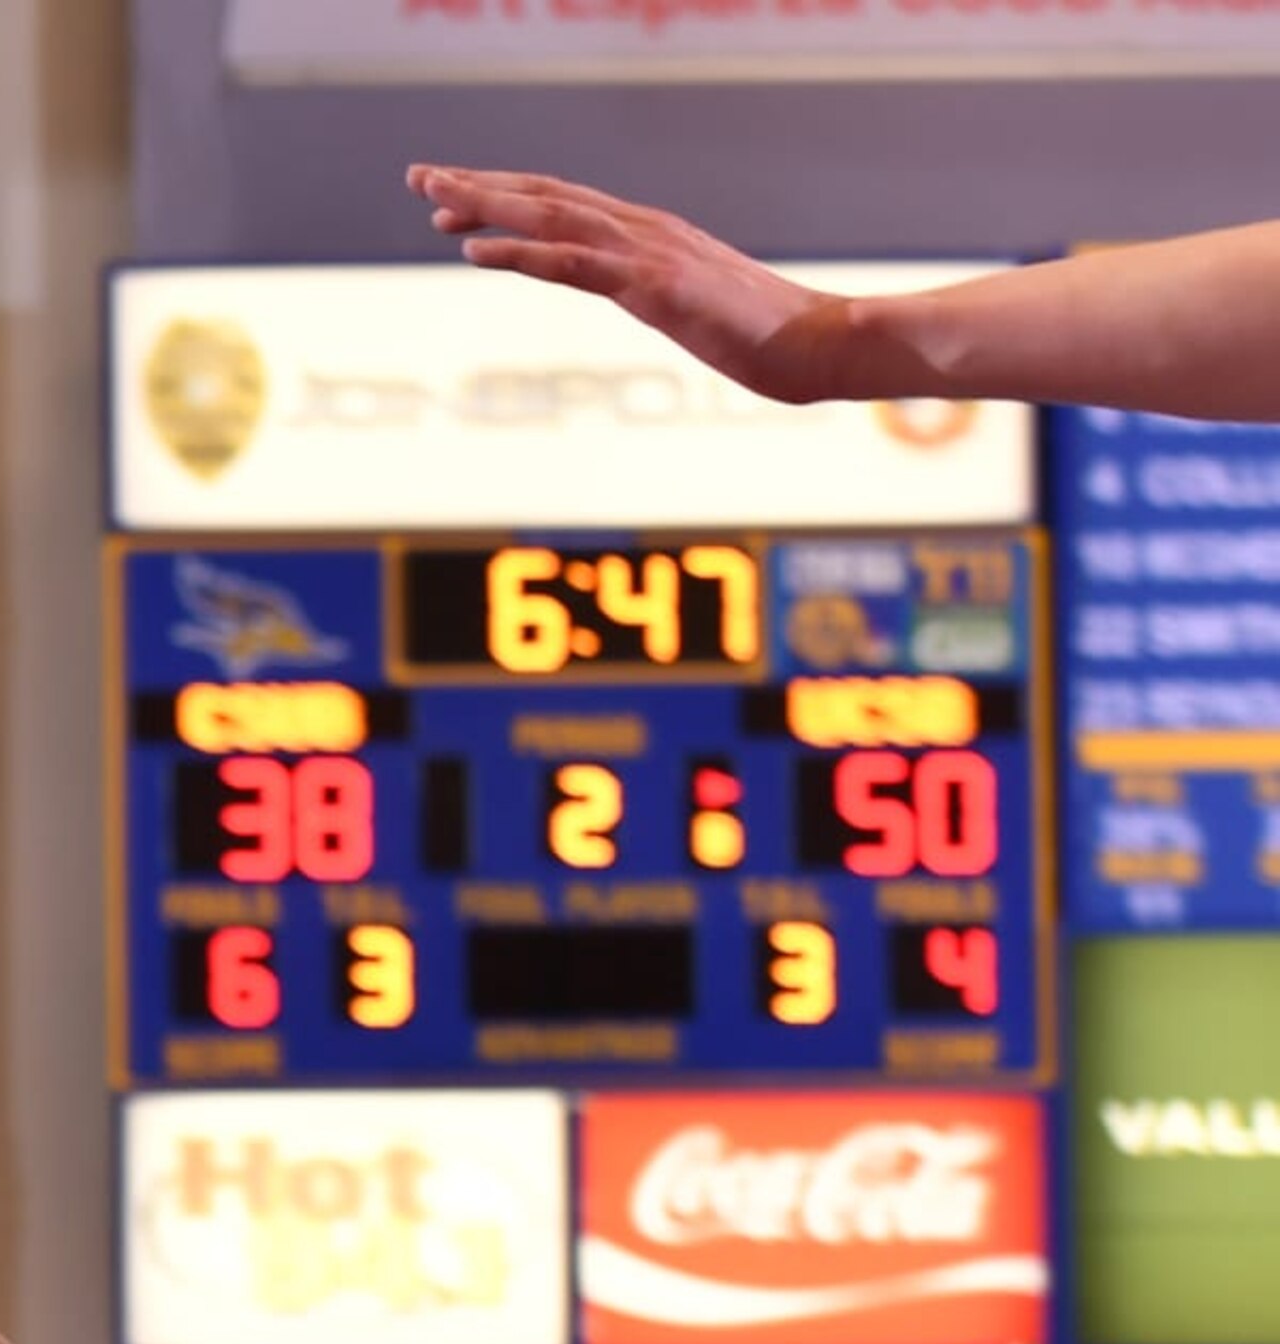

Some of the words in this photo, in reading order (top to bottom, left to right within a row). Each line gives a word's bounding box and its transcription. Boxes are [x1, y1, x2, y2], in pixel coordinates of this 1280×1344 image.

[486, 545, 761, 674] 6:47
[217, 755, 375, 882] 38
[548, 763, 624, 869] 2
[835, 750, 998, 878] 50
[206, 924, 280, 1030] 6
[347, 922, 416, 1030] 3
[768, 919, 838, 1026] 3
[925, 926, 998, 1017] 4
